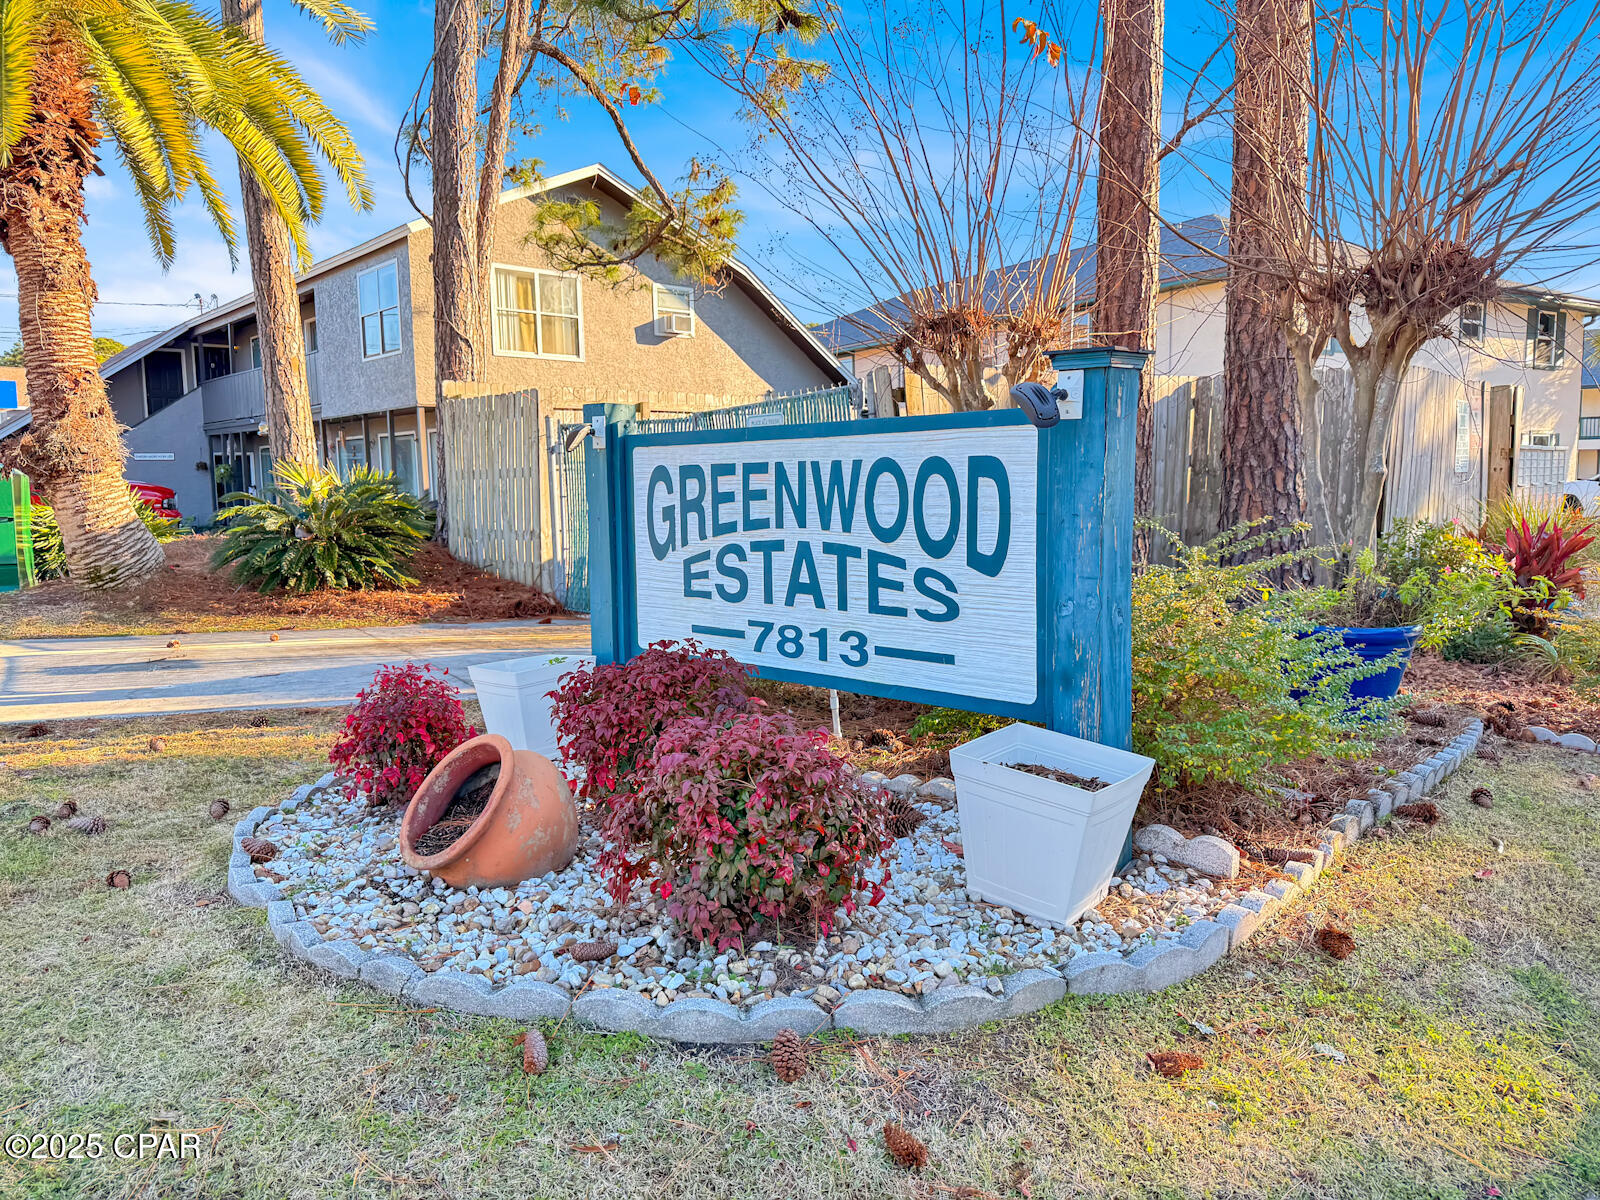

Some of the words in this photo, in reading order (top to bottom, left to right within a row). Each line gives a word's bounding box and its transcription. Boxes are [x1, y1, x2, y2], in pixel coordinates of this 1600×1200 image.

[646, 455, 1012, 577] GREENWOOD
[683, 539, 960, 622] ESTATES
[748, 619, 869, 668] 7813
